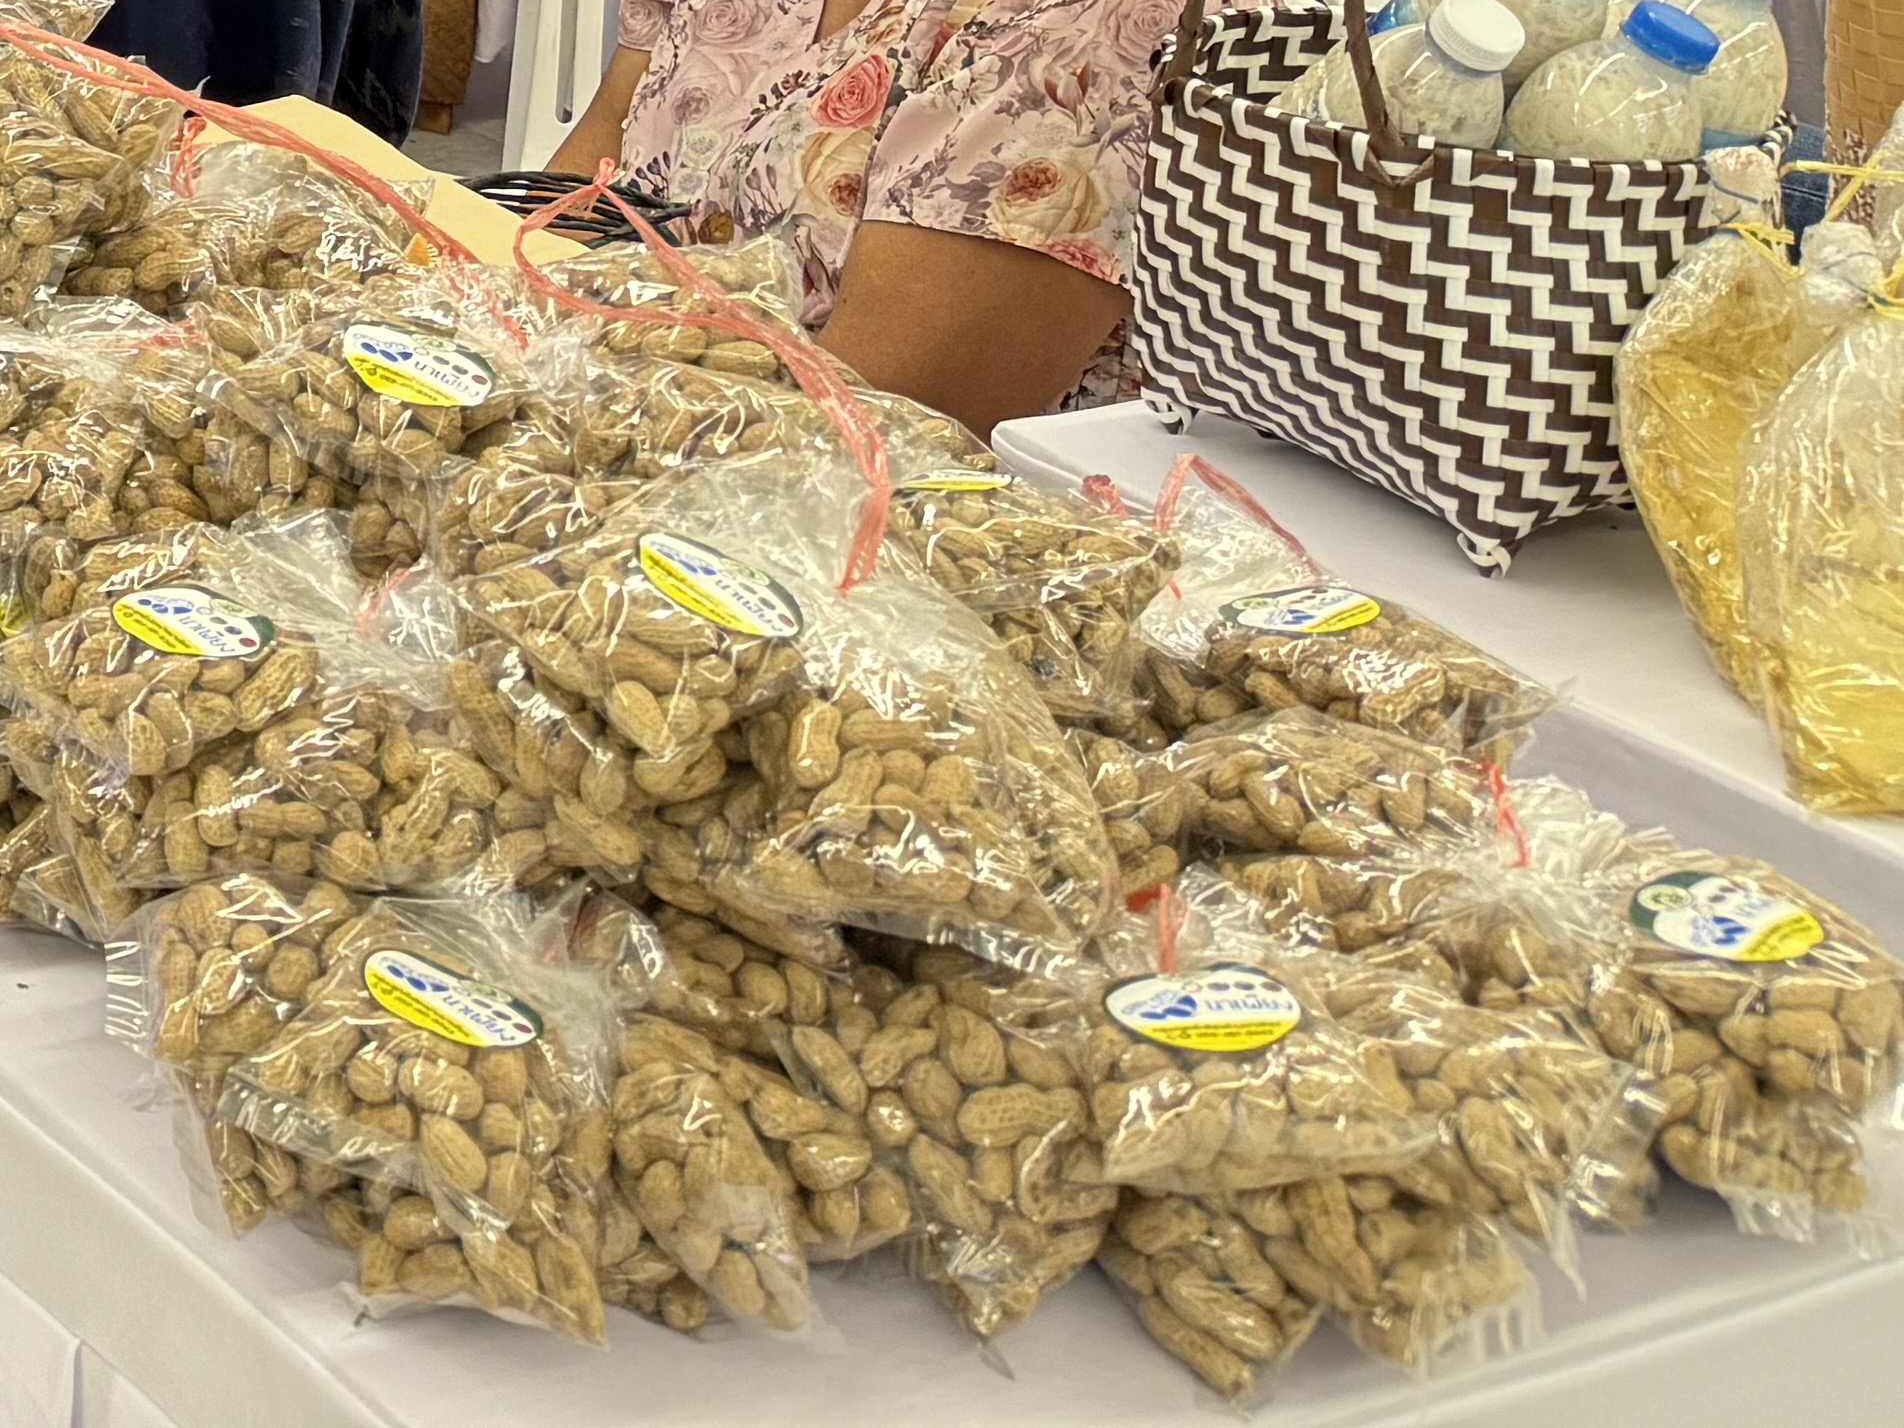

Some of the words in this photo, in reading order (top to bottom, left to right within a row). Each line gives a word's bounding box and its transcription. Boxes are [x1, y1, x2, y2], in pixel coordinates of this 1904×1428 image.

[413, 359, 480, 398] นาเพียง
[715, 579, 783, 630] นาเพียง
[178, 615, 236, 652] นาเพียง
[441, 993, 516, 1040] นาเพียง
[1206, 994, 1293, 1010] นาเพียง
